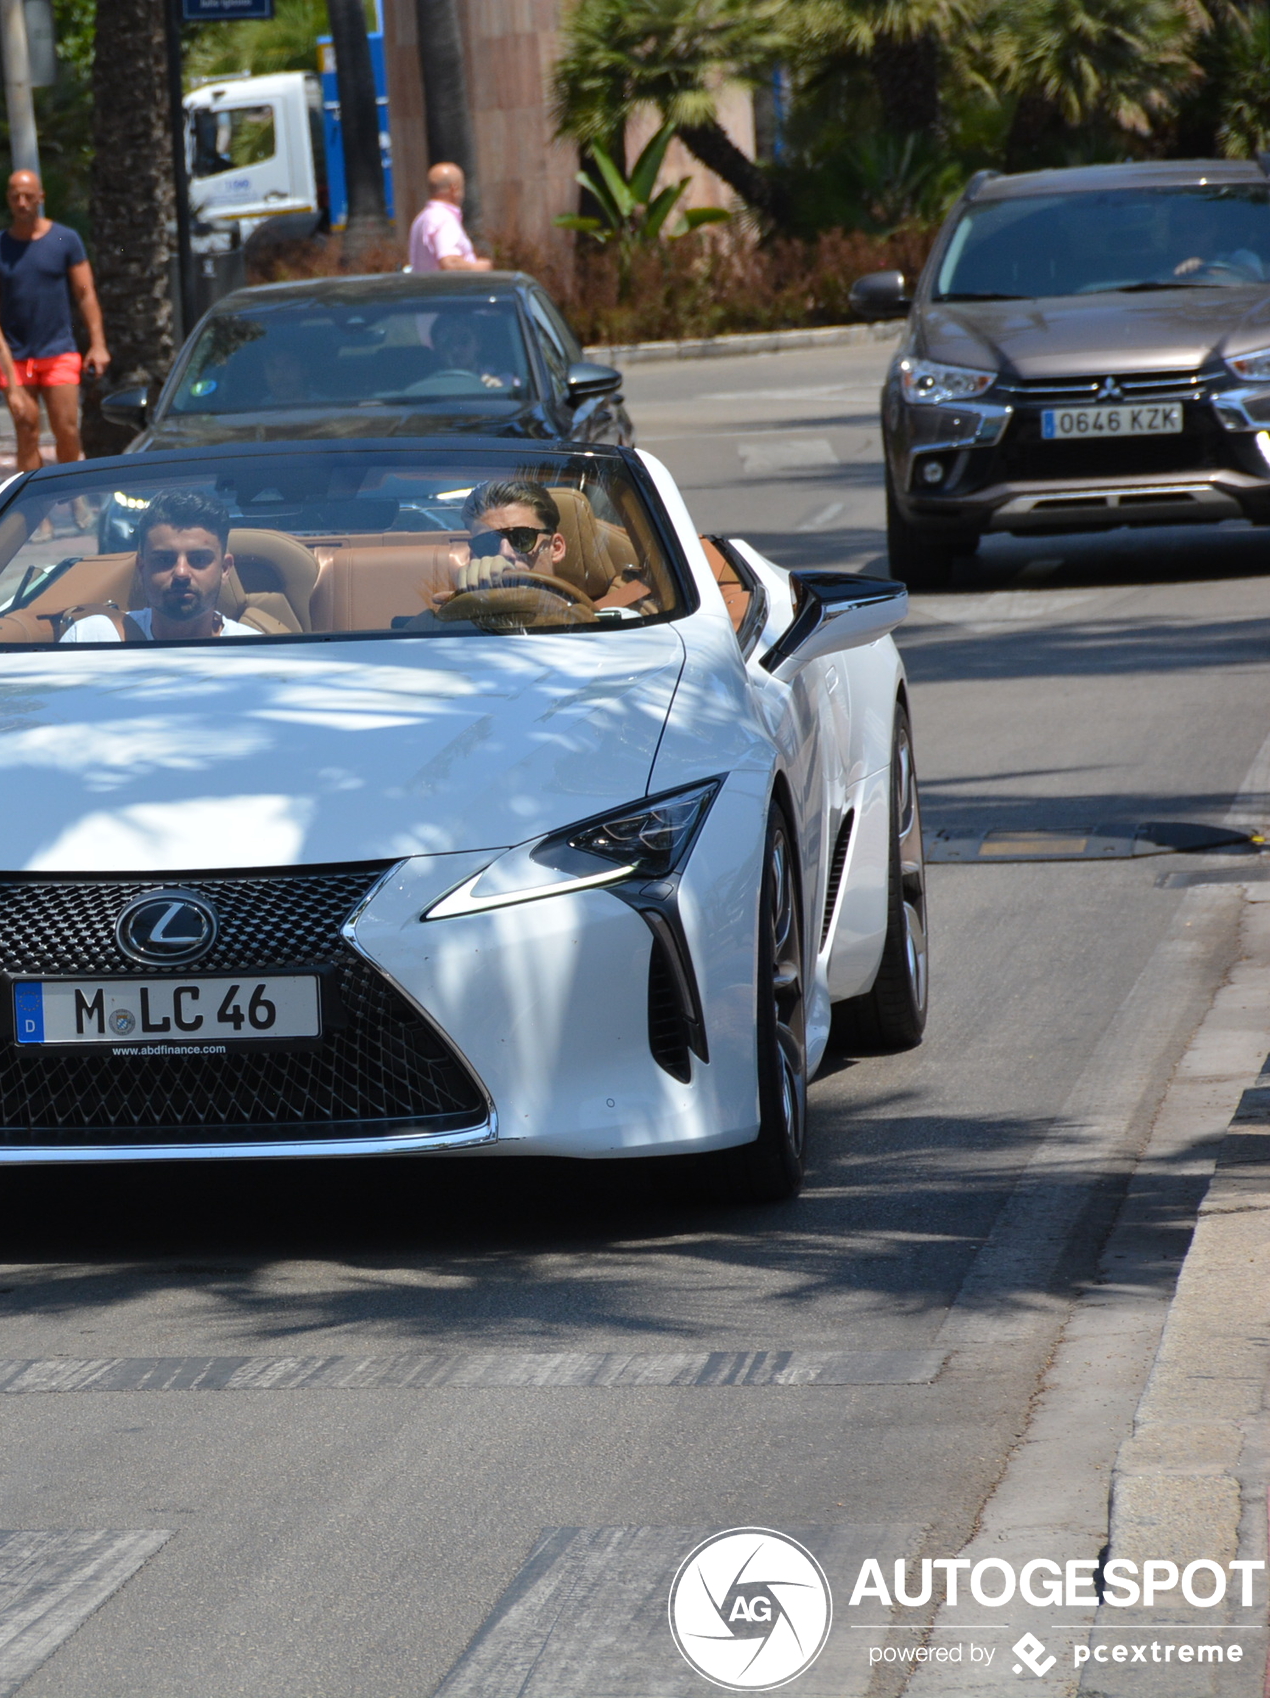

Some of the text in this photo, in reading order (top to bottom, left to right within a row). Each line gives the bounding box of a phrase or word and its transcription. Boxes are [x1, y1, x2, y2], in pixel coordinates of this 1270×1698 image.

[1060, 408, 1176, 433] 0646 KZK
[25, 1019, 35, 1033] D
[75, 988, 105, 1034] M
[140, 986, 204, 1032] LC
[217, 984, 276, 1031] 46
[112, 1044, 226, 1056] www.abdfinance.com
